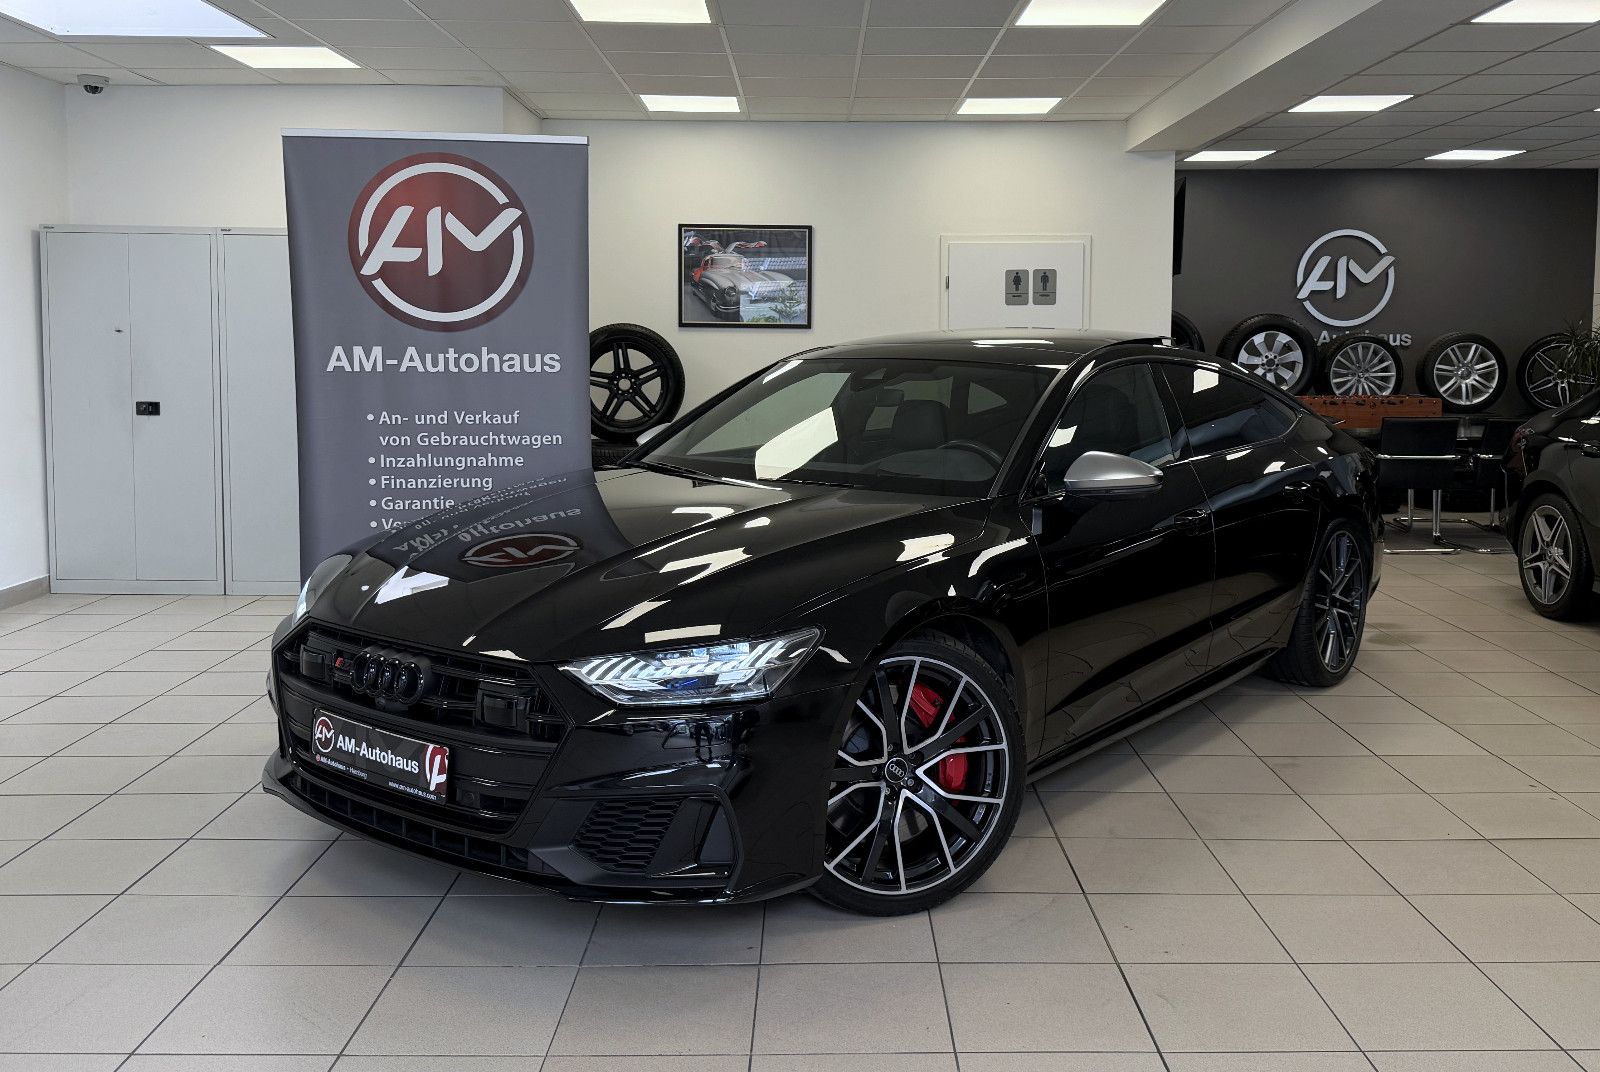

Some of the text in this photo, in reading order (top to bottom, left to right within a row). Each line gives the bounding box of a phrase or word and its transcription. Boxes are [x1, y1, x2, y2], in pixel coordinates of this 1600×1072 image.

[326, 345, 561, 373] AM-Autohaus
[379, 410, 520, 425] An- und Verkauf
[379, 432, 563, 449] von Gebrauchtwagen
[380, 453, 524, 469] Inzahlungnahme
[381, 475, 494, 491] Finanzierung
[381, 496, 455, 510] Garantie
[336, 734, 420, 774] AM-Autohaus
